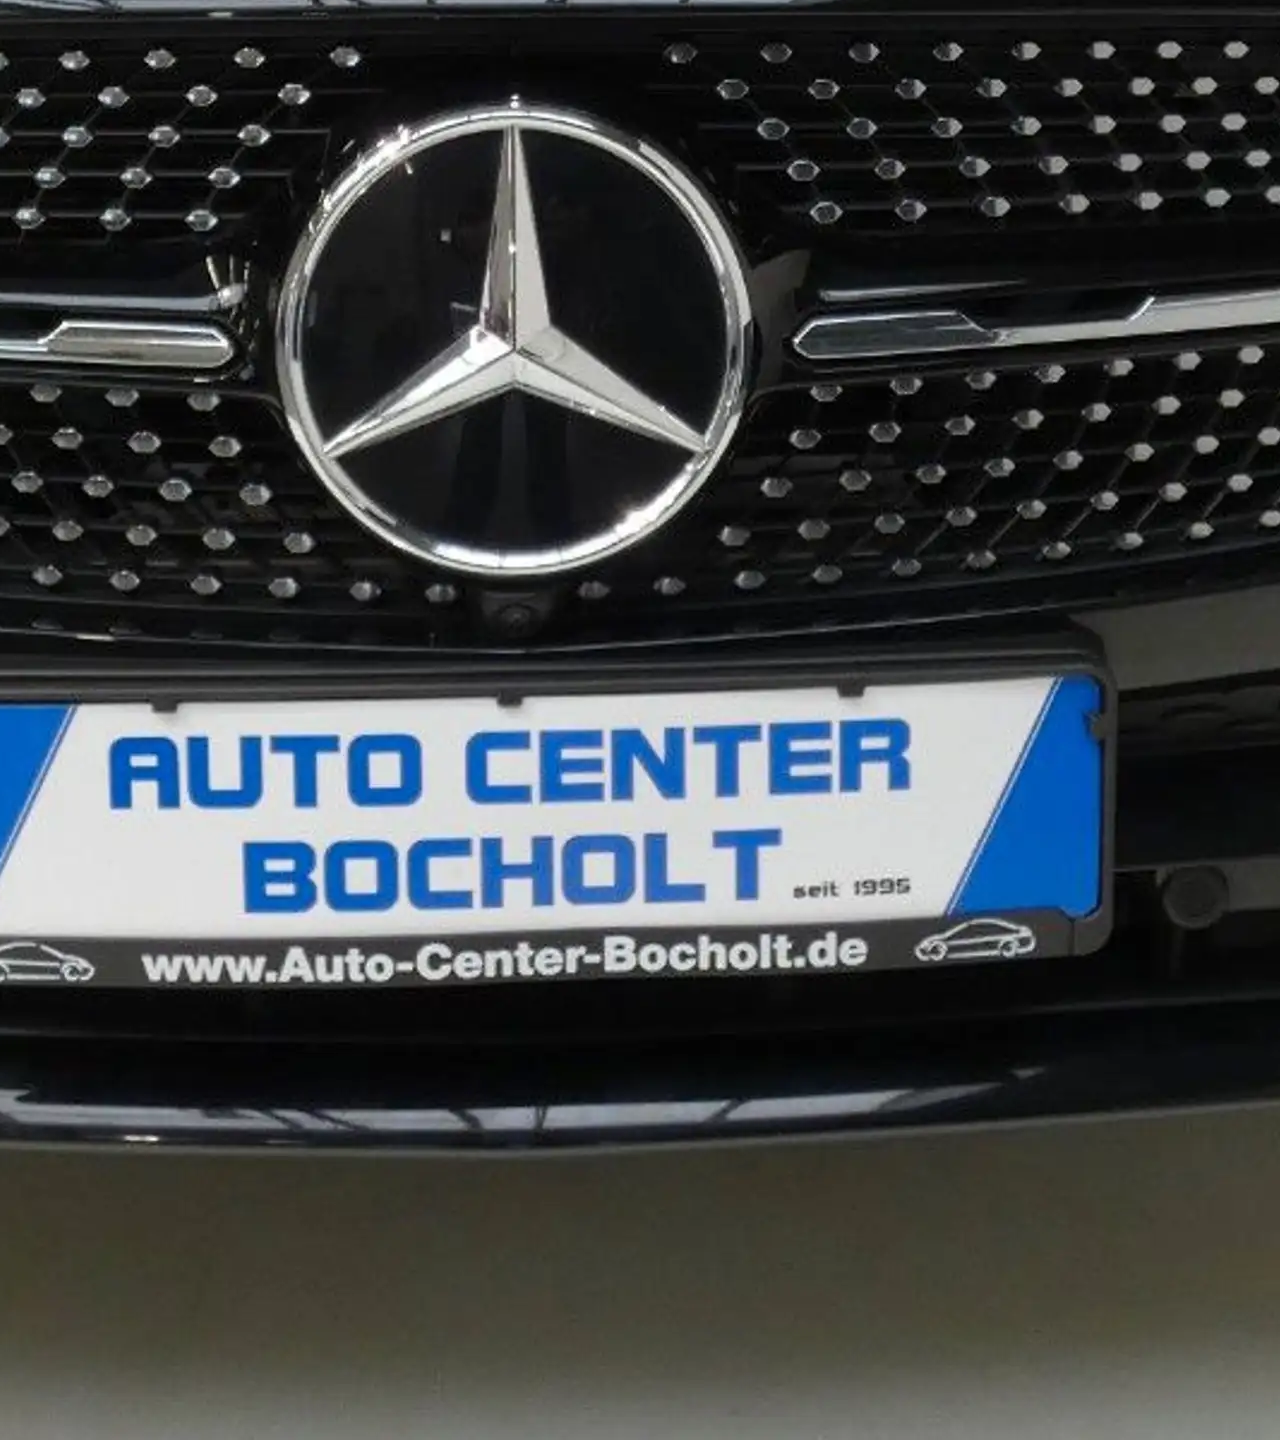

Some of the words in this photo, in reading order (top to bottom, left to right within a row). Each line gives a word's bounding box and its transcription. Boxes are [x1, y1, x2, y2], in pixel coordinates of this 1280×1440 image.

[107, 732, 424, 812] AUTO
[463, 716, 913, 807] CENTER
[240, 827, 784, 916] BOCHOLT
[792, 880, 840, 901] seit
[852, 877, 913, 898] 1995
[141, 931, 869, 986] www.Auto-Center-Bocholt.de
